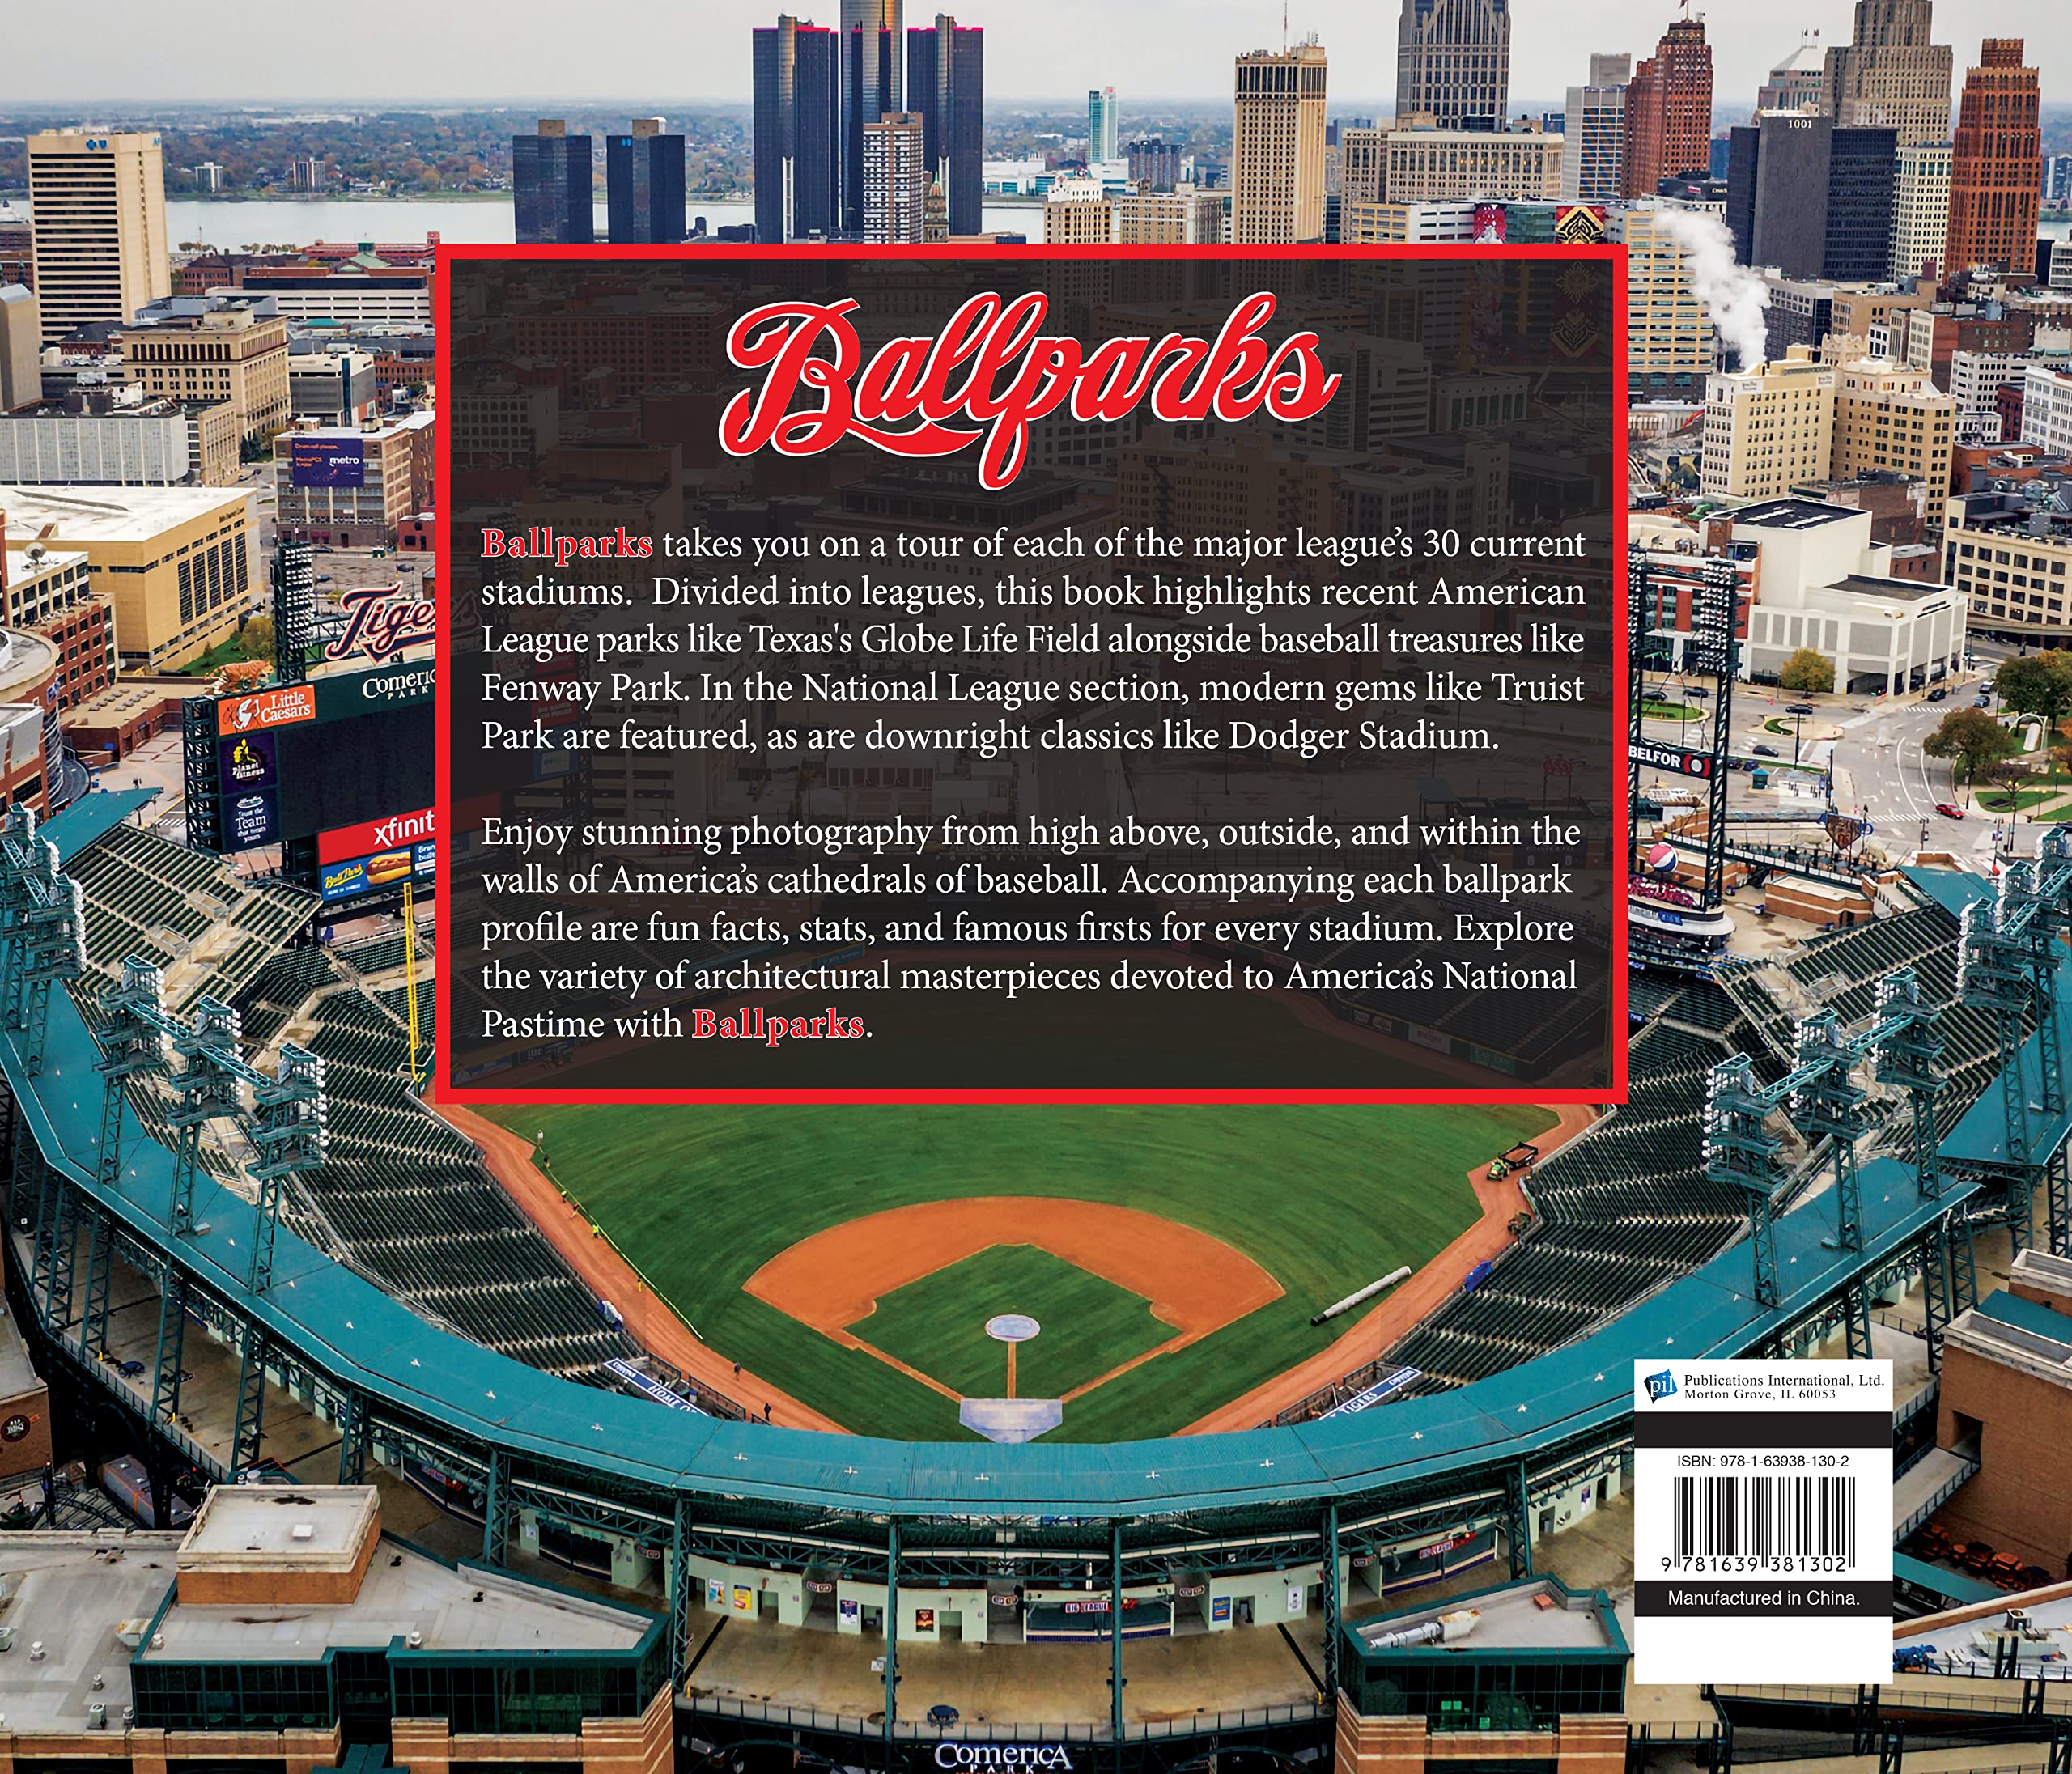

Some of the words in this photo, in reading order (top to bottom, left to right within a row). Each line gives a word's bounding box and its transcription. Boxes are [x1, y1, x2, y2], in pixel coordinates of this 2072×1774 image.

[1789, 119, 1812, 129] 1001
[329, 456, 359, 467] metro
[325, 580, 435, 660] Tige
[270, 691, 305, 709] Little
[388, 686, 428, 700] PARK
[261, 704, 311, 724] Caesars
[1628, 745, 1681, 768] BELFOR
[232, 762, 259, 776] planet
[236, 768, 265, 779] fitness
[235, 815, 267, 830] Team
[374, 810, 435, 847] xfinit
[648, 1385, 681, 1406] HOME
[1339, 1391, 1378, 1414] TIGERS
[1065, 1602, 1080, 1614] BIG
